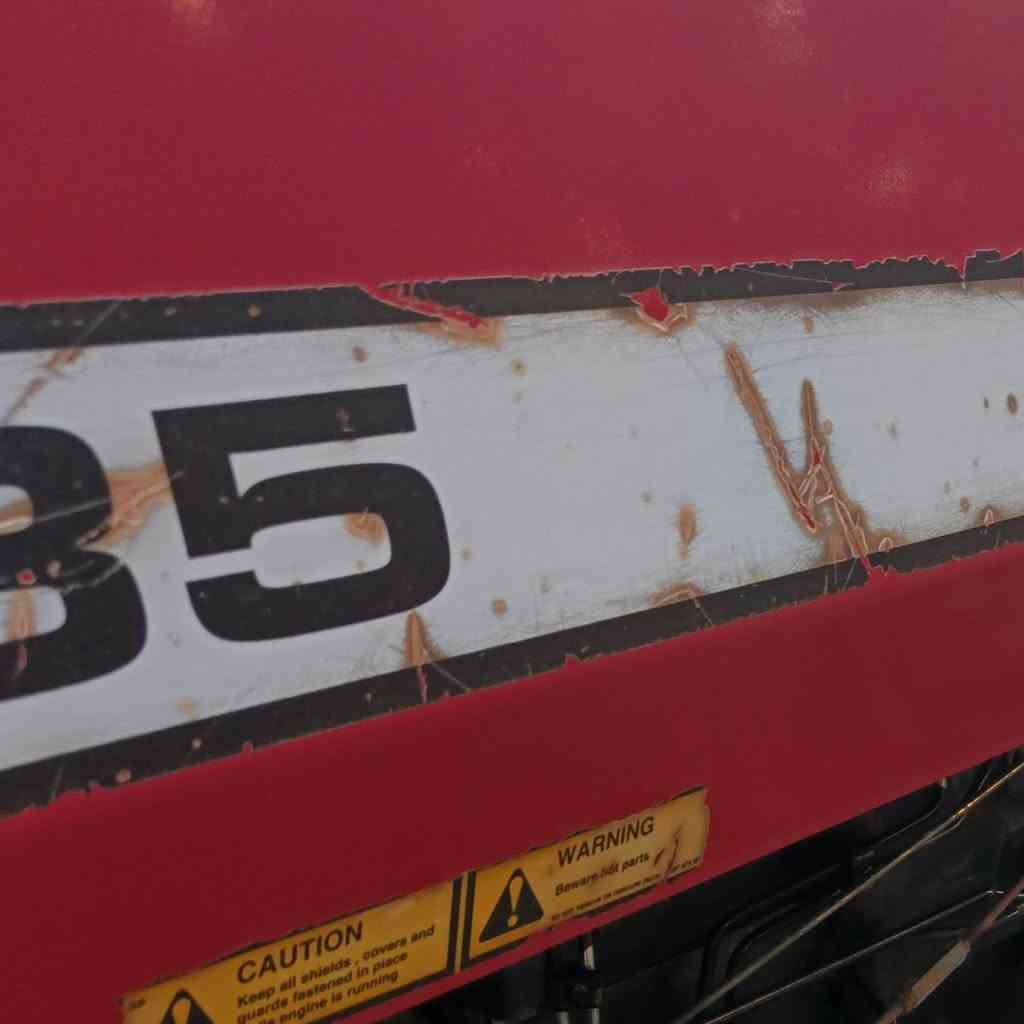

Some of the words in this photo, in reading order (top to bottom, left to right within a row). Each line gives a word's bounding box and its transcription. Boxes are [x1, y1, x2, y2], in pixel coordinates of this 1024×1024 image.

[557, 816, 654, 867] WARNING
[555, 871, 599, 896] Beware
[622, 852, 650, 872] parts
[236, 920, 363, 984] CAUTION
[237, 984, 275, 1009] Keep
[280, 976, 297, 993] all
[363, 938, 407, 961] covers
[410, 925, 435, 943] and
[293, 971, 352, 1003] fastened
[356, 965, 369, 978] in
[373, 951, 408, 975] place
[331, 991, 343, 1004] is
[347, 971, 399, 997] running
